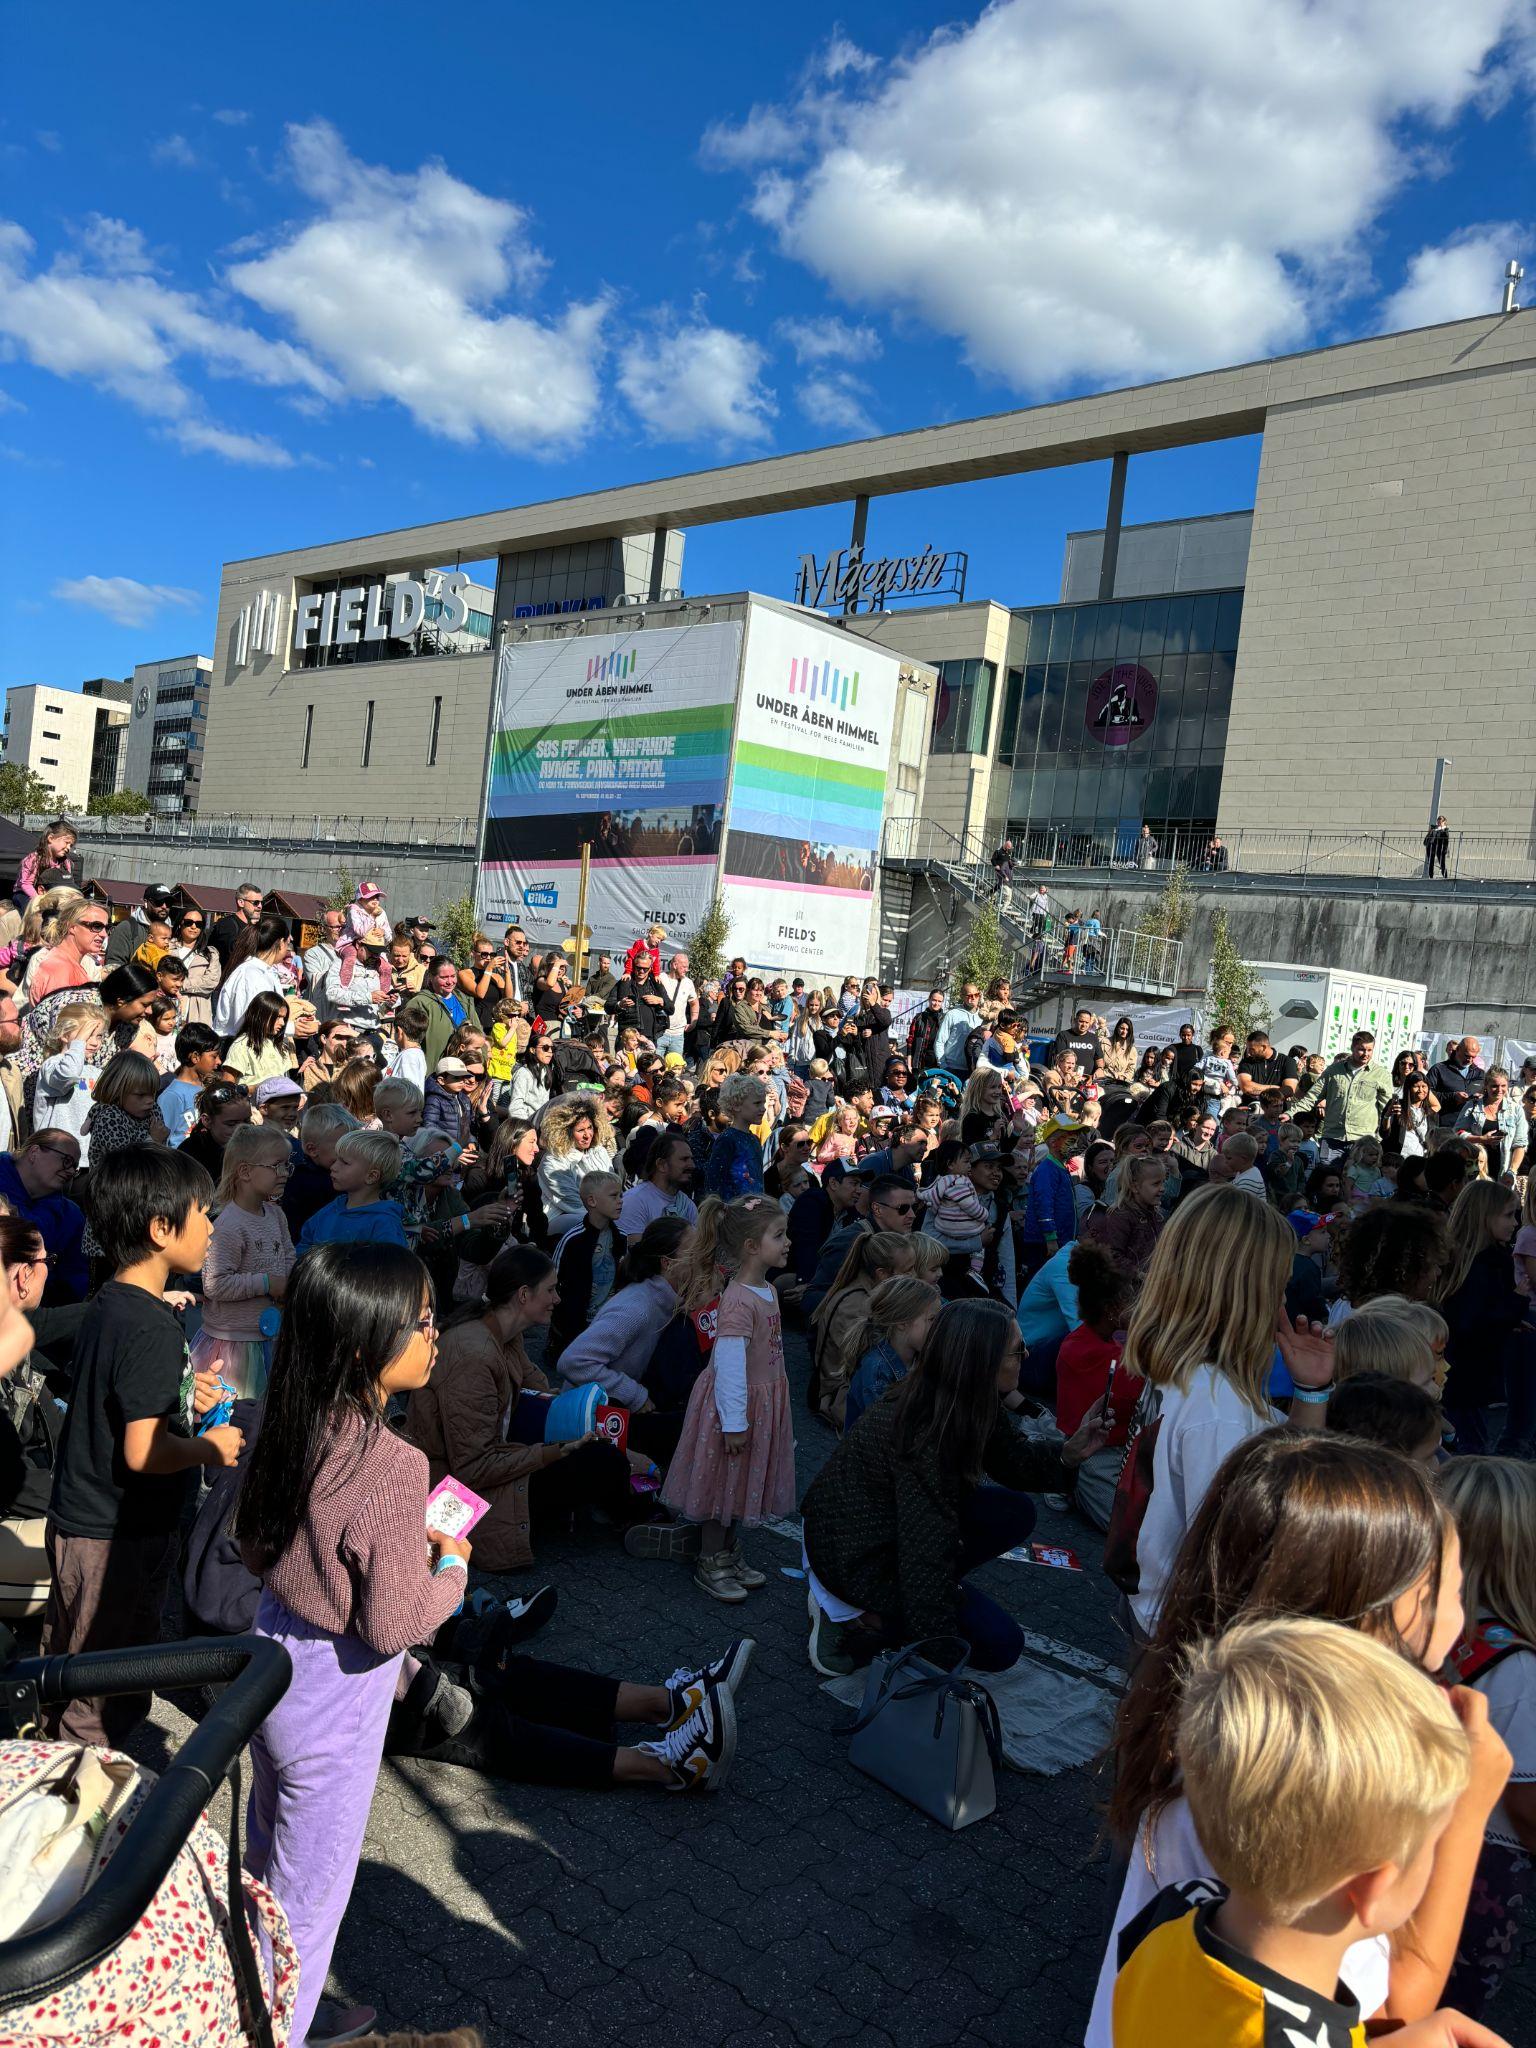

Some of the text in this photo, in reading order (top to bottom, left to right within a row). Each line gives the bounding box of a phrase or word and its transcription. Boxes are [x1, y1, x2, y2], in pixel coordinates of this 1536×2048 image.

[798, 543, 947, 615] Magasin
[295, 571, 471, 650] FIELD'S
[566, 684, 653, 698] UNDER ÅBEN HIMMEL
[756, 693, 879, 745] UNDER ÅBEN HIMMEL
[770, 717, 864, 752] EN FESTIVAL FOR HELE FAMILIEN
[618, 758, 666, 778] PATROL
[527, 892, 554, 905] Bilka
[525, 915, 553, 925] CoolGray
[644, 910, 686, 925] FIELD'S
[778, 925, 816, 942] FIELD'S
[768, 941, 824, 956] SHOPPING CENTER
[1069, 1042, 1093, 1050] HUGO
[1138, 1033, 1175, 1044] CoolGray
